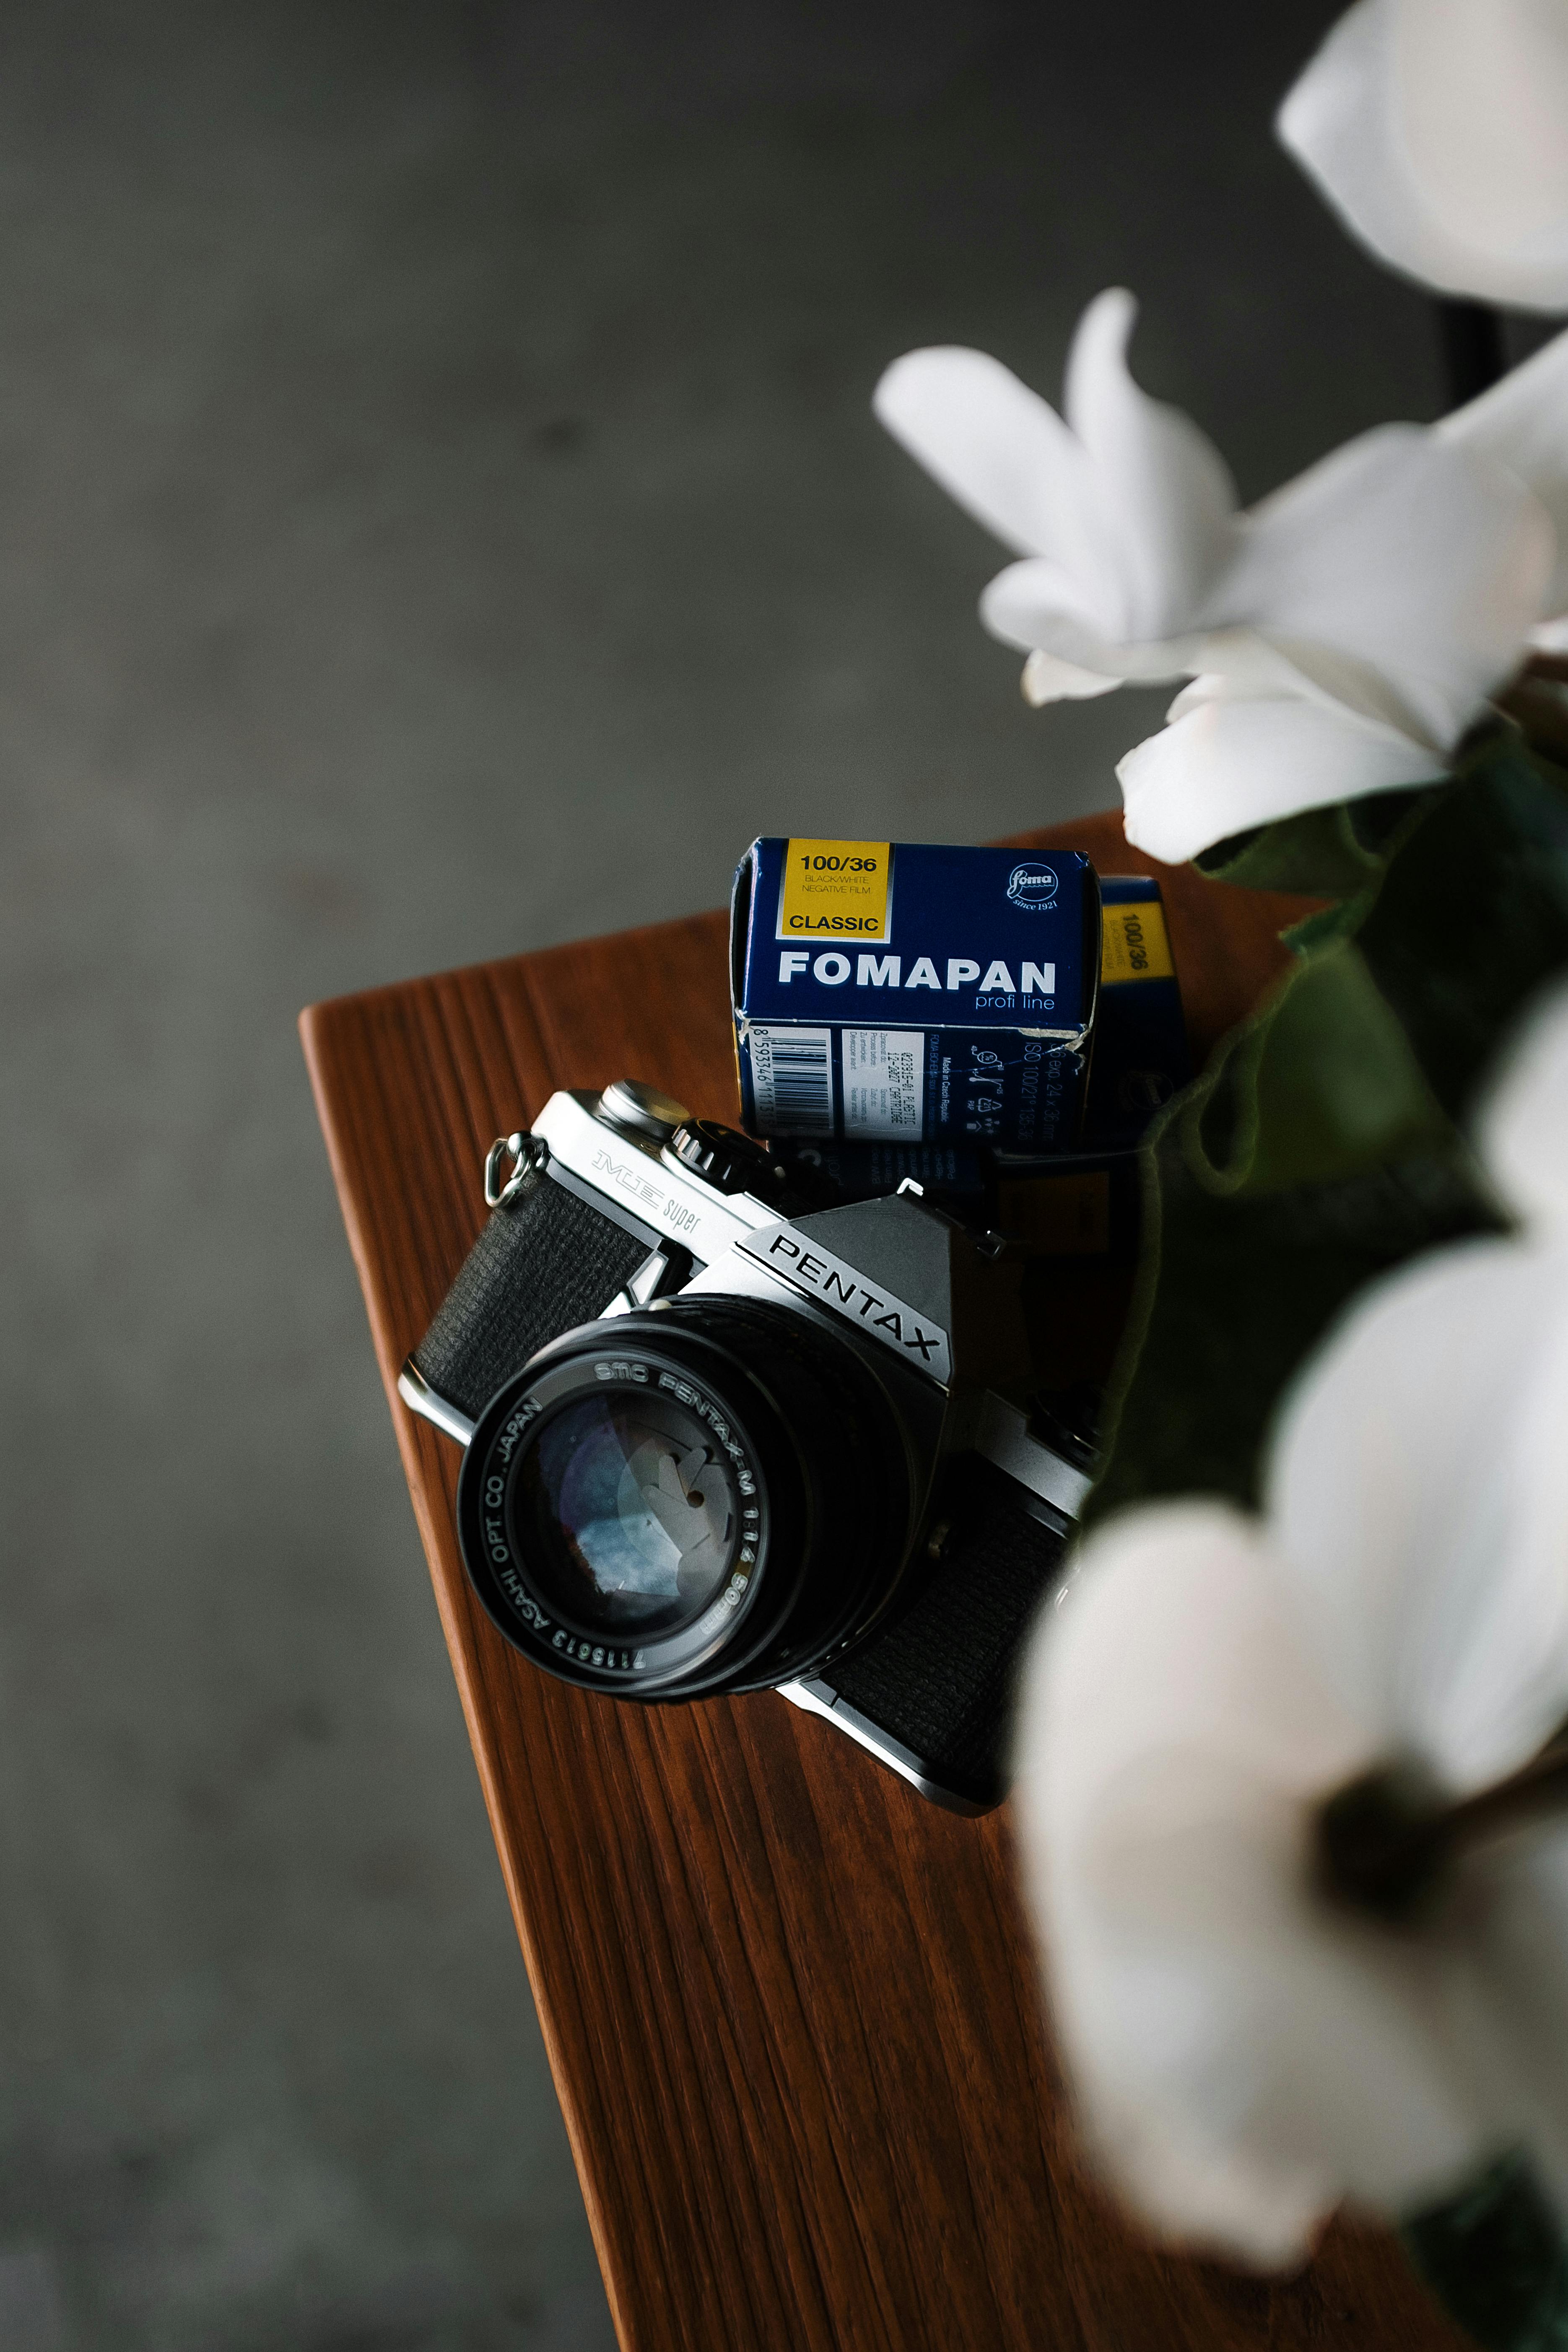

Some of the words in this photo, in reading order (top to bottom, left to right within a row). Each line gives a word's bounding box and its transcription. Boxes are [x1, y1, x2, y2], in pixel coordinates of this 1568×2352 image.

[801, 856, 877, 872] 100/36
[802, 885, 847, 893] NEGATIVE
[805, 875, 869, 884] BLACK/WHITE
[1007, 870, 1053, 897] foma
[1013, 900, 1036, 910] since
[1038, 900, 1057, 910] 1921
[789, 915, 878, 931] CLASSIC
[1123, 914, 1148, 970] 100/36
[779, 951, 1055, 994] FOMAPAN
[976, 994, 1015, 1010] profi
[1023, 995, 1054, 1010] line
[930, 1034, 939, 1051] FOMA
[1024, 1042, 1042, 1062] ISO
[755, 1042, 771, 1081] 593346
[888, 1052, 900, 1083] 12-2027
[929, 1052, 939, 1078] BOHEMIA
[942, 1057, 951, 1074] Made
[1045, 1060, 1062, 1080] exp.
[942, 1081, 950, 1098] Czech
[1046, 1083, 1062, 1096] 24
[903, 1096, 916, 1125] PLASTIC
[940, 1099, 950, 1122] Republic
[1043, 1109, 1060, 1122] 36
[1017, 1107, 1035, 1141] 135-36
[592, 1149, 665, 1210] ME
[663, 1199, 701, 1233] super
[769, 1234, 940, 1361] PENTAX
[496, 1397, 543, 1463] JAPAN
[658, 1372, 756, 1496] PENTAX-M
[740, 1507, 759, 1563] 1:1.4
[500, 1568, 551, 1630] ASAHI
